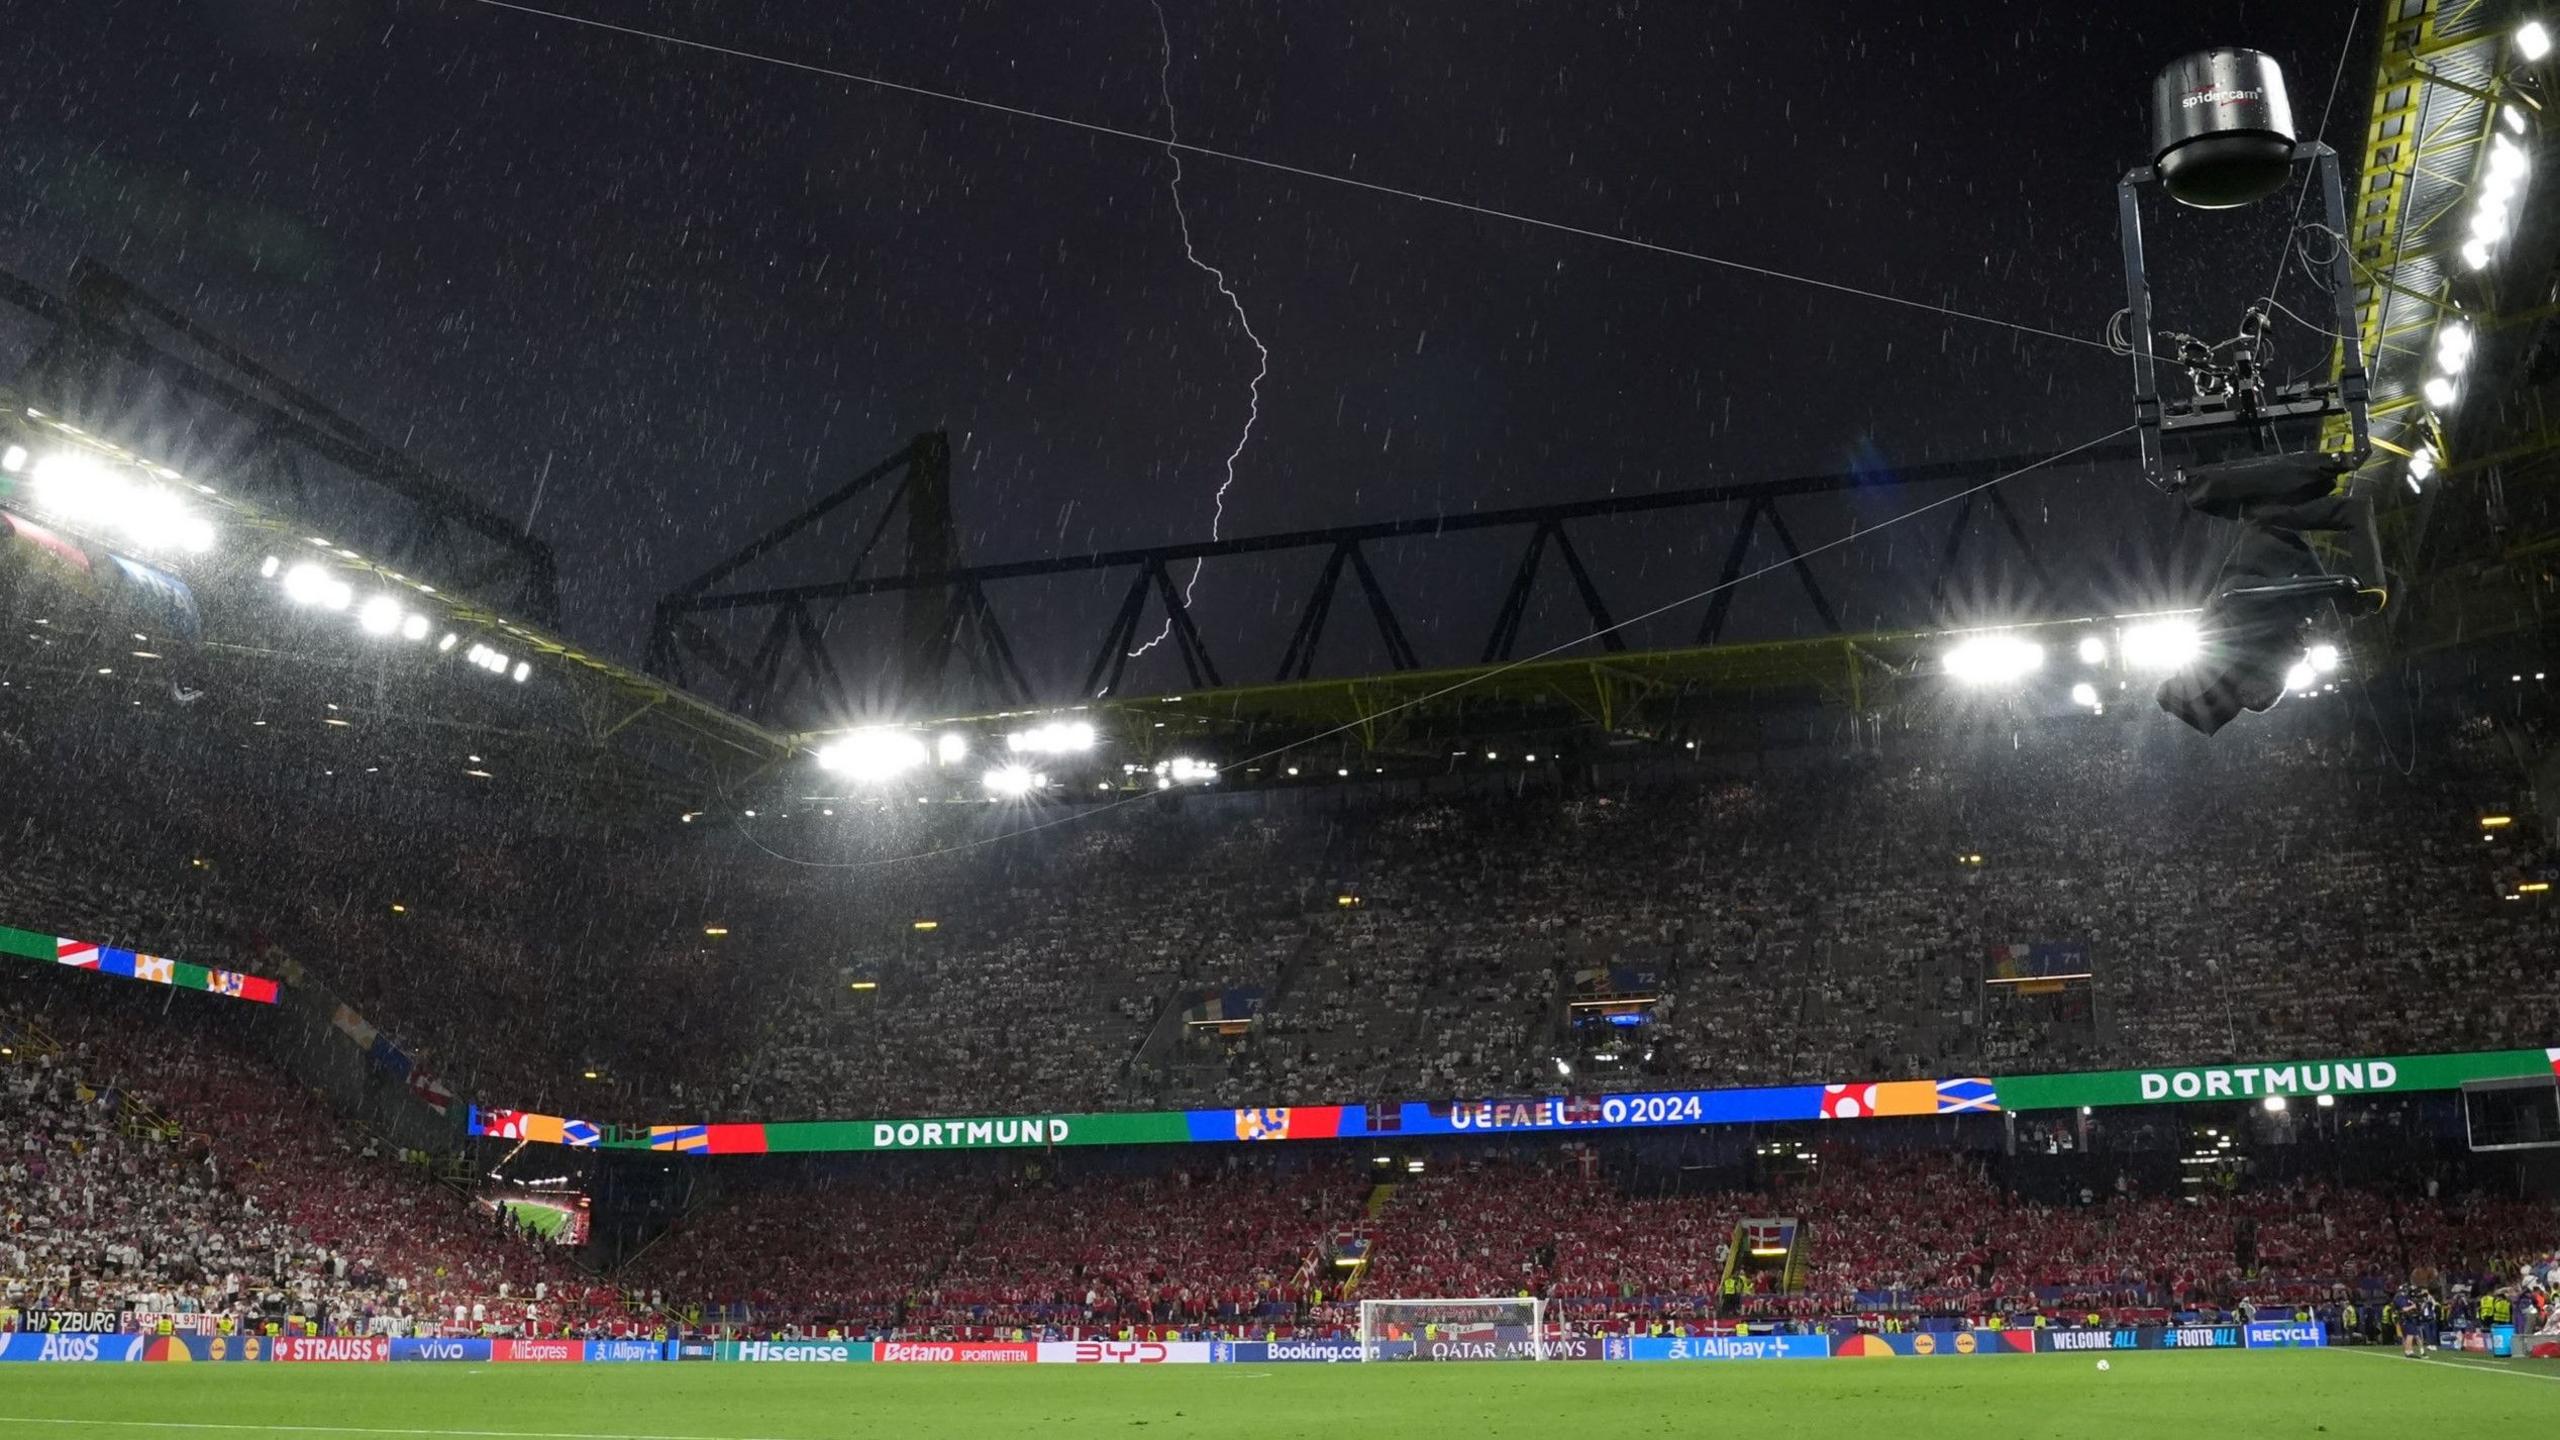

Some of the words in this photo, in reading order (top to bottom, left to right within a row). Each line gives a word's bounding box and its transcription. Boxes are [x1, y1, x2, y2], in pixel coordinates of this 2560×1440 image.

[2182, 90, 2258, 108] spidercam
[1638, 972, 1656, 984] 72
[2140, 1061, 2398, 1100] DORTMUND
[873, 1119, 1069, 1147] DORTMUND
[183, 1313, 195, 1325] 93
[2053, 1331, 2112, 1349] WELCOME
[2113, 1330, 2138, 1348] ALL
[2163, 1328, 2238, 1348] #FOOTBALL
[2251, 1327, 2319, 1342] RECYCLE
[294, 1338, 371, 1360] STRAUSS
[420, 1340, 463, 1359] vivo
[509, 1340, 568, 1360] AliExpress
[739, 1341, 848, 1362] Hisense
[883, 1342, 953, 1362] Betano
[960, 1349, 1028, 1361] SPORTWETTEN
[1076, 1343, 1167, 1363] BYD
[1268, 1342, 1380, 1362] Booking.com
[1431, 1342, 1497, 1358] QATAR
[1505, 1340, 1587, 1359] AIRWAYS
